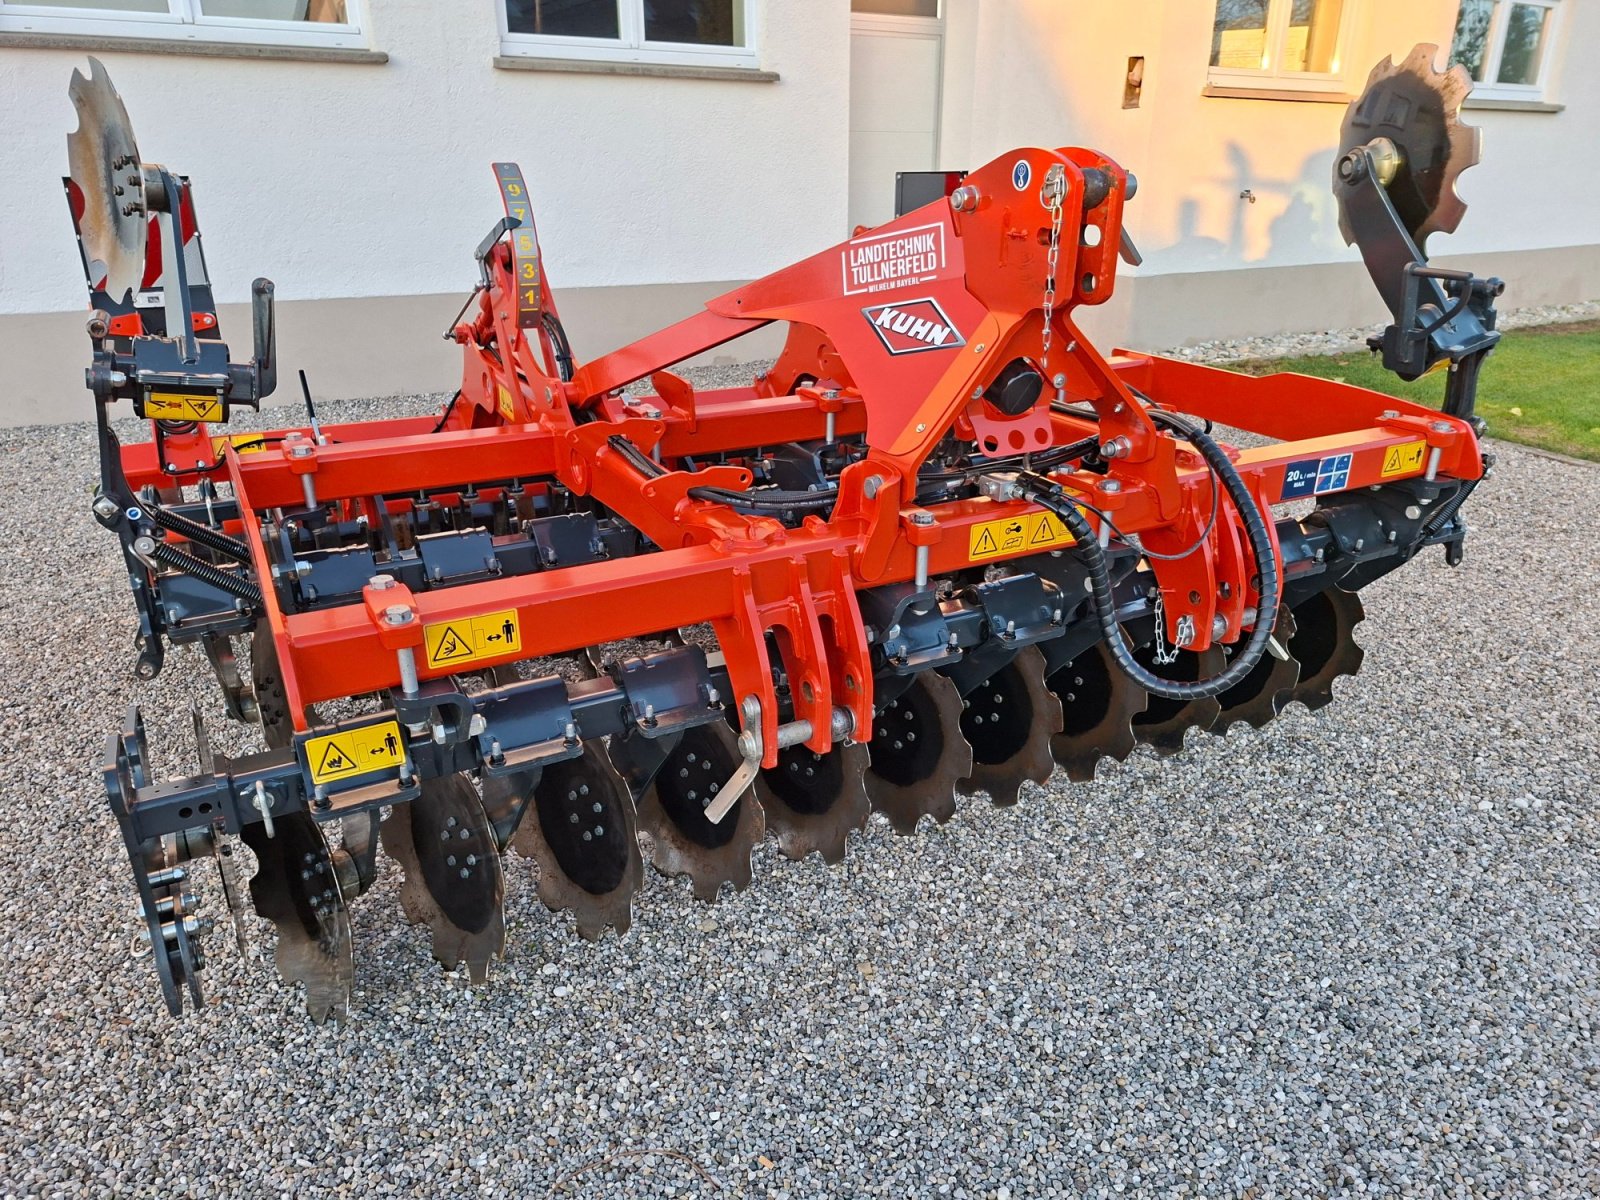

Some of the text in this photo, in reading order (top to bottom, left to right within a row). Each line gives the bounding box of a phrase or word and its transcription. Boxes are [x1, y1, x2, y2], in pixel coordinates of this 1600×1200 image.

[507, 184, 521, 197] 9
[514, 208, 525, 222] 7
[519, 235, 532, 251] 5
[850, 232, 935, 267] LANDTECHNIK
[523, 263, 535, 279] 3
[851, 252, 937, 285] TULLNERFELD
[868, 277, 921, 293] WILHELM BAYERL
[525, 290, 534, 305] 1
[875, 307, 951, 346] KUHN
[1286, 470, 1300, 482] 20
